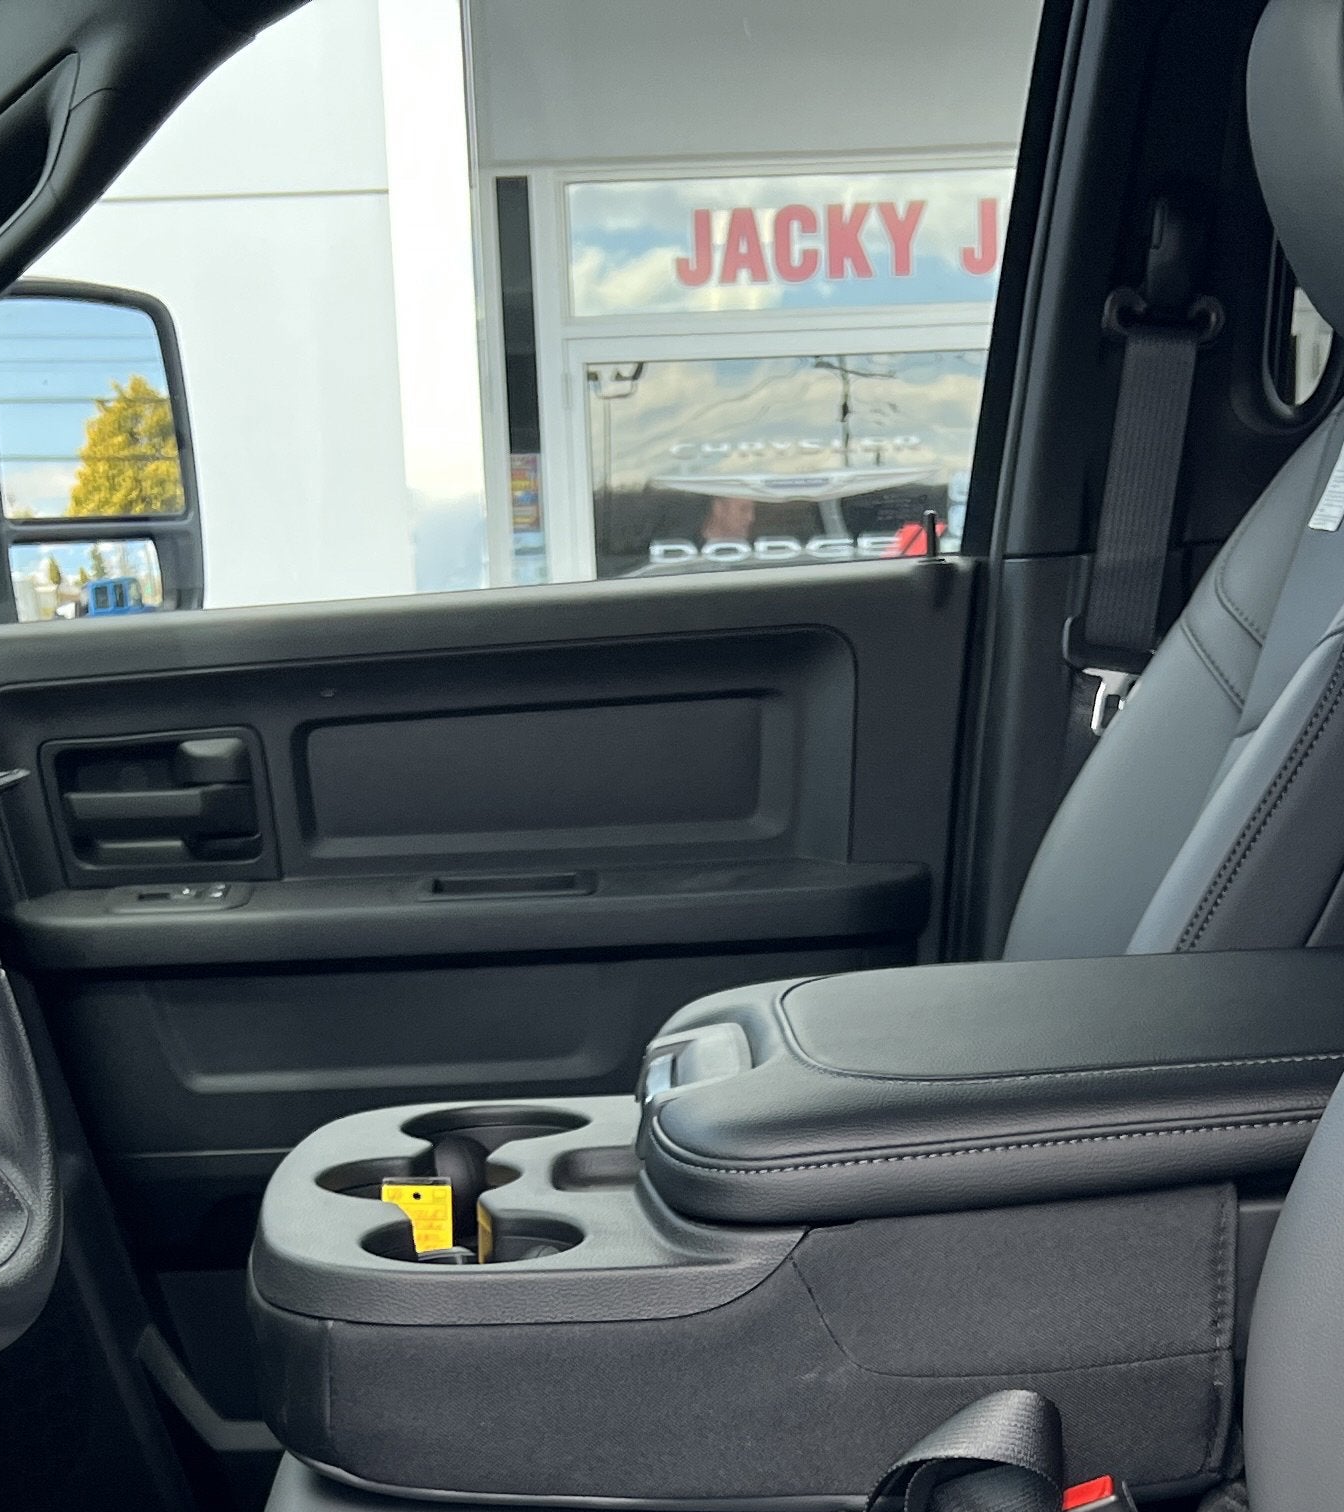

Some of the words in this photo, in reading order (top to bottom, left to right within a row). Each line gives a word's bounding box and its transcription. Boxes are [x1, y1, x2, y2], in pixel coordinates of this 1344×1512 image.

[675, 200, 927, 287] JACKY
[961, 198, 999, 276] J
[649, 532, 900, 564] DODGE
